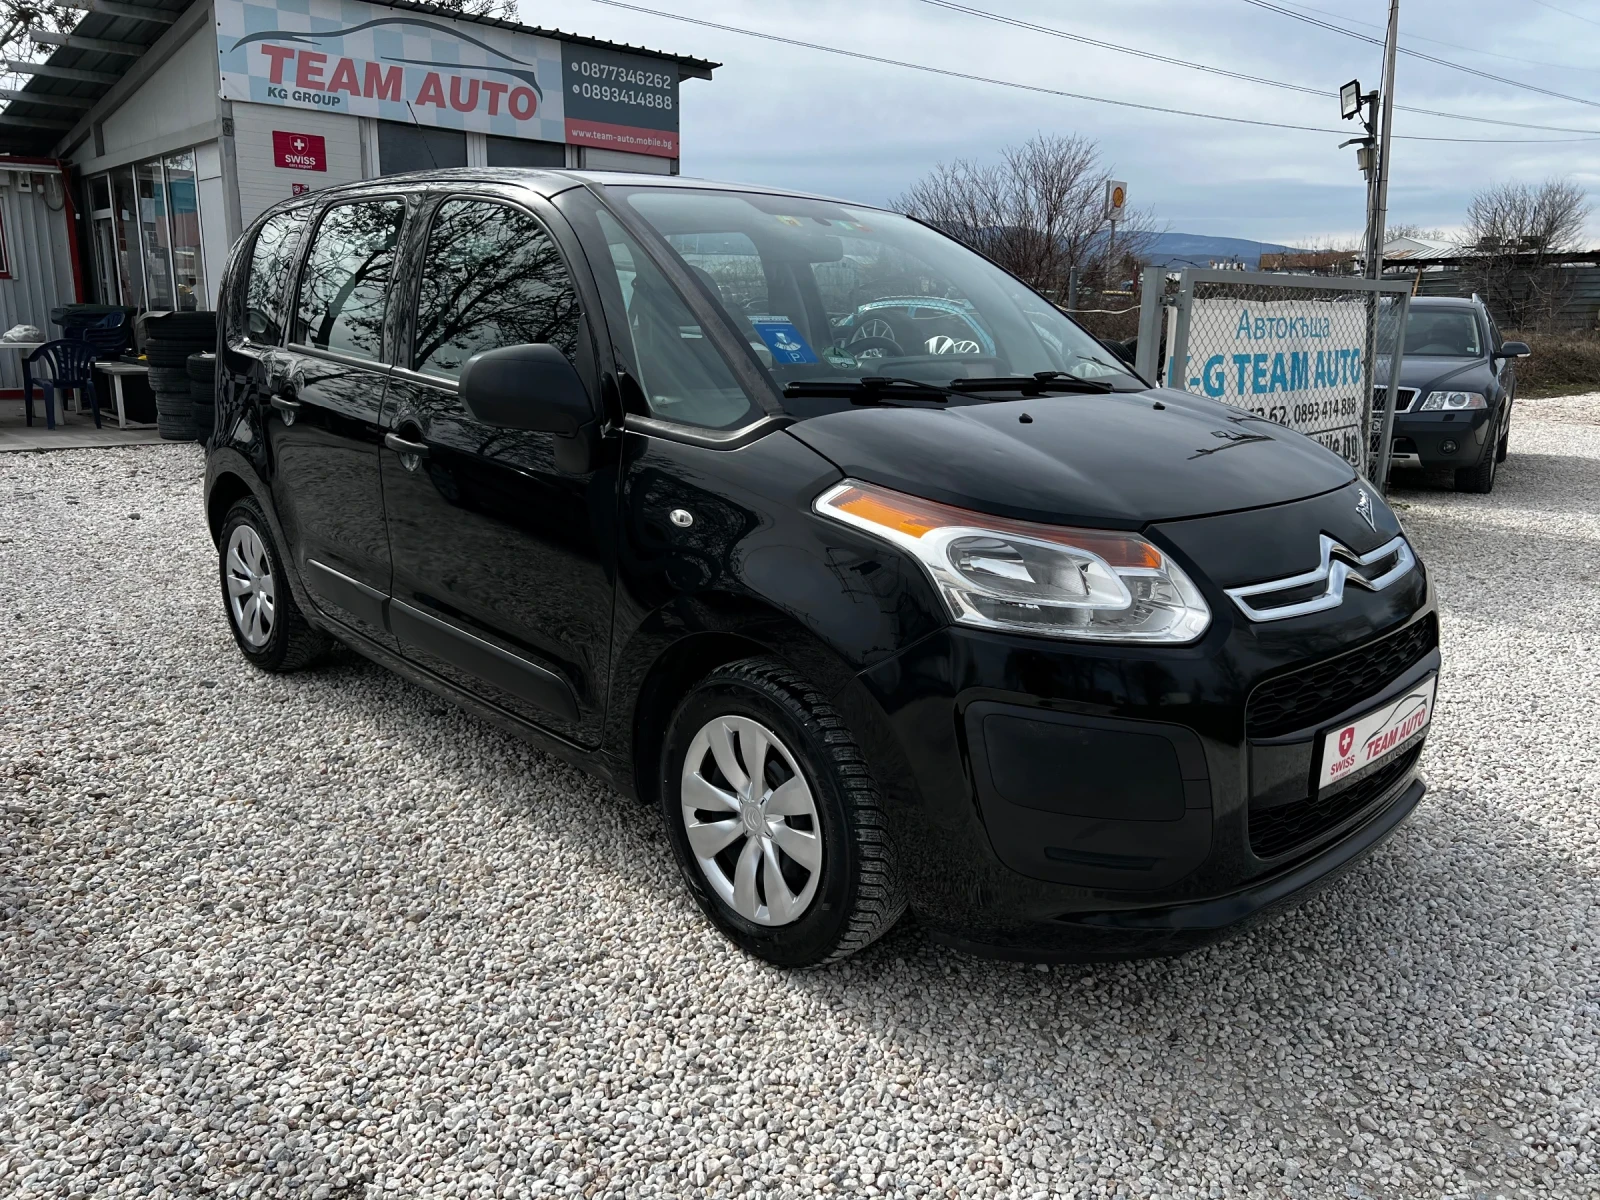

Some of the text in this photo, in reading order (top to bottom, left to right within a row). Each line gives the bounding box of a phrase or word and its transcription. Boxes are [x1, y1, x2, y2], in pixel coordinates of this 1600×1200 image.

[261, 43, 538, 121] TEAM AUTO
[581, 61, 671, 90] 0877346262
[267, 86, 341, 107] KG GROUP
[582, 83, 672, 110] 0893414888
[571, 129, 673, 150] www.team-auto.mobile.bg
[285, 154, 316, 166] SWISS
[1235, 309, 1331, 340] Автокъща
[1233, 351, 1309, 395] TEAM
[1313, 348, 1361, 389] AUTO
[1294, 402, 1320, 424] 0893
[1322, 399, 1339, 420] 414
[1341, 396, 1357, 417] 888
[1366, 707, 1426, 761] TEAM AUTO
[1330, 754, 1356, 776] SWISS
